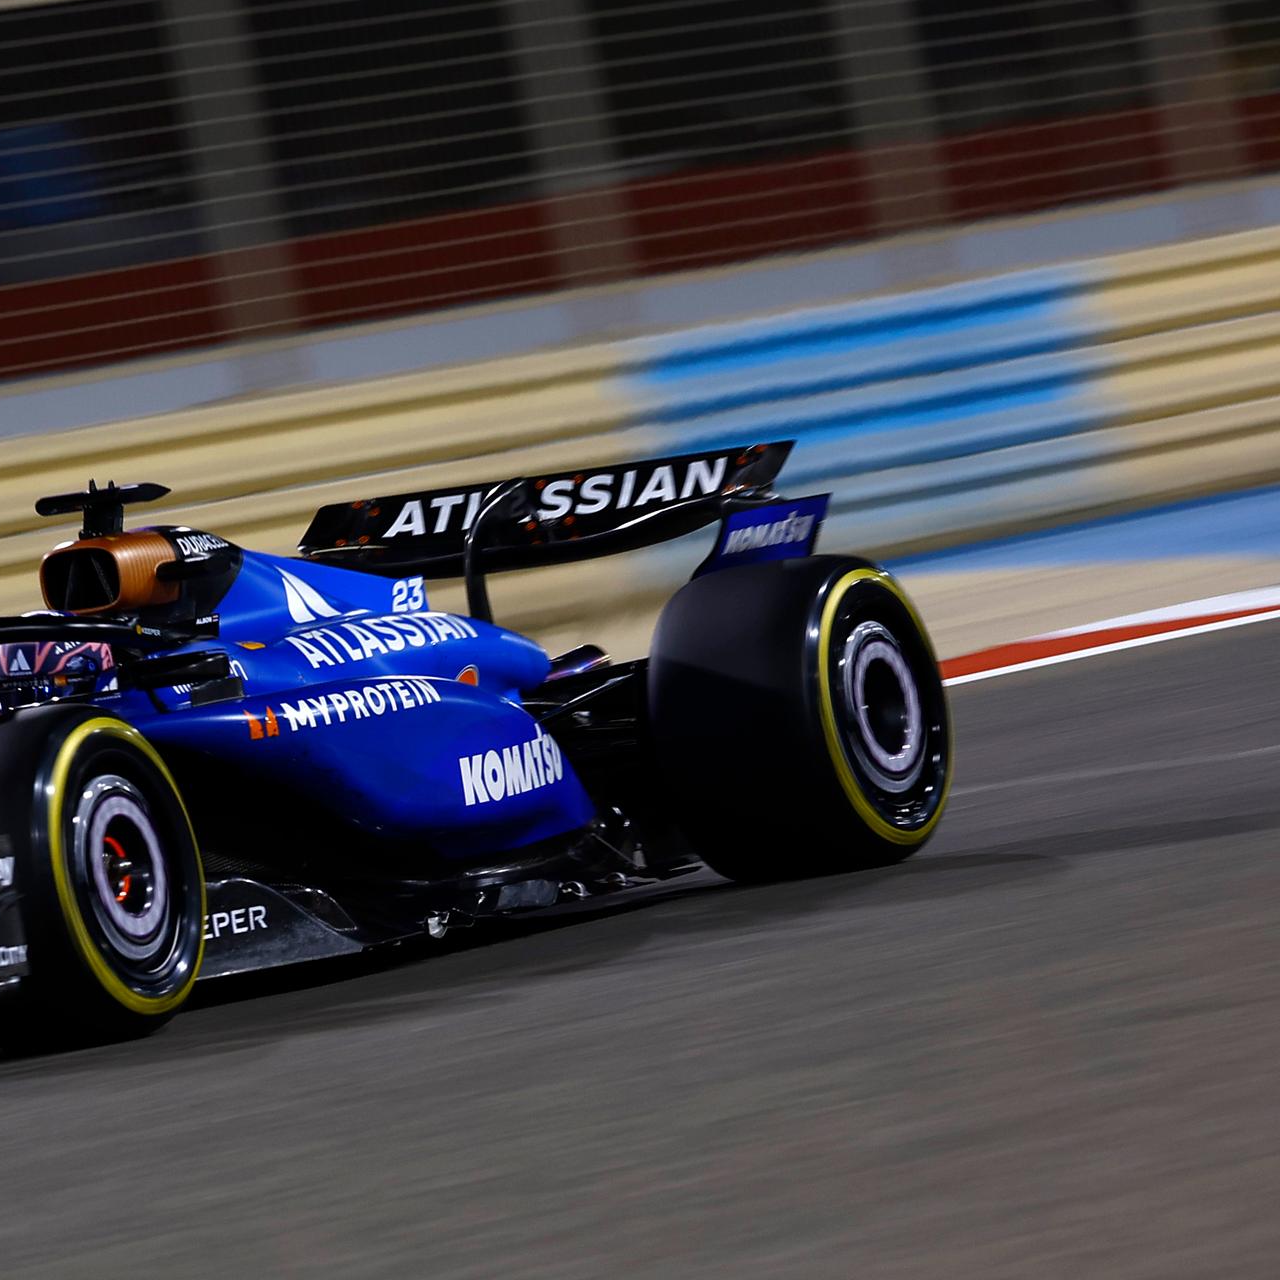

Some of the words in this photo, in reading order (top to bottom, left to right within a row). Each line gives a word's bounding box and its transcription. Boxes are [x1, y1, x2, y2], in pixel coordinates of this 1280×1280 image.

[382, 457, 728, 539] ATLSSIAN
[392, 576, 425, 613] 23
[285, 611, 479, 669] ATLASSIAN
[280, 679, 441, 732] MYPROTEIN
[459, 722, 564, 807] KOMATSU
